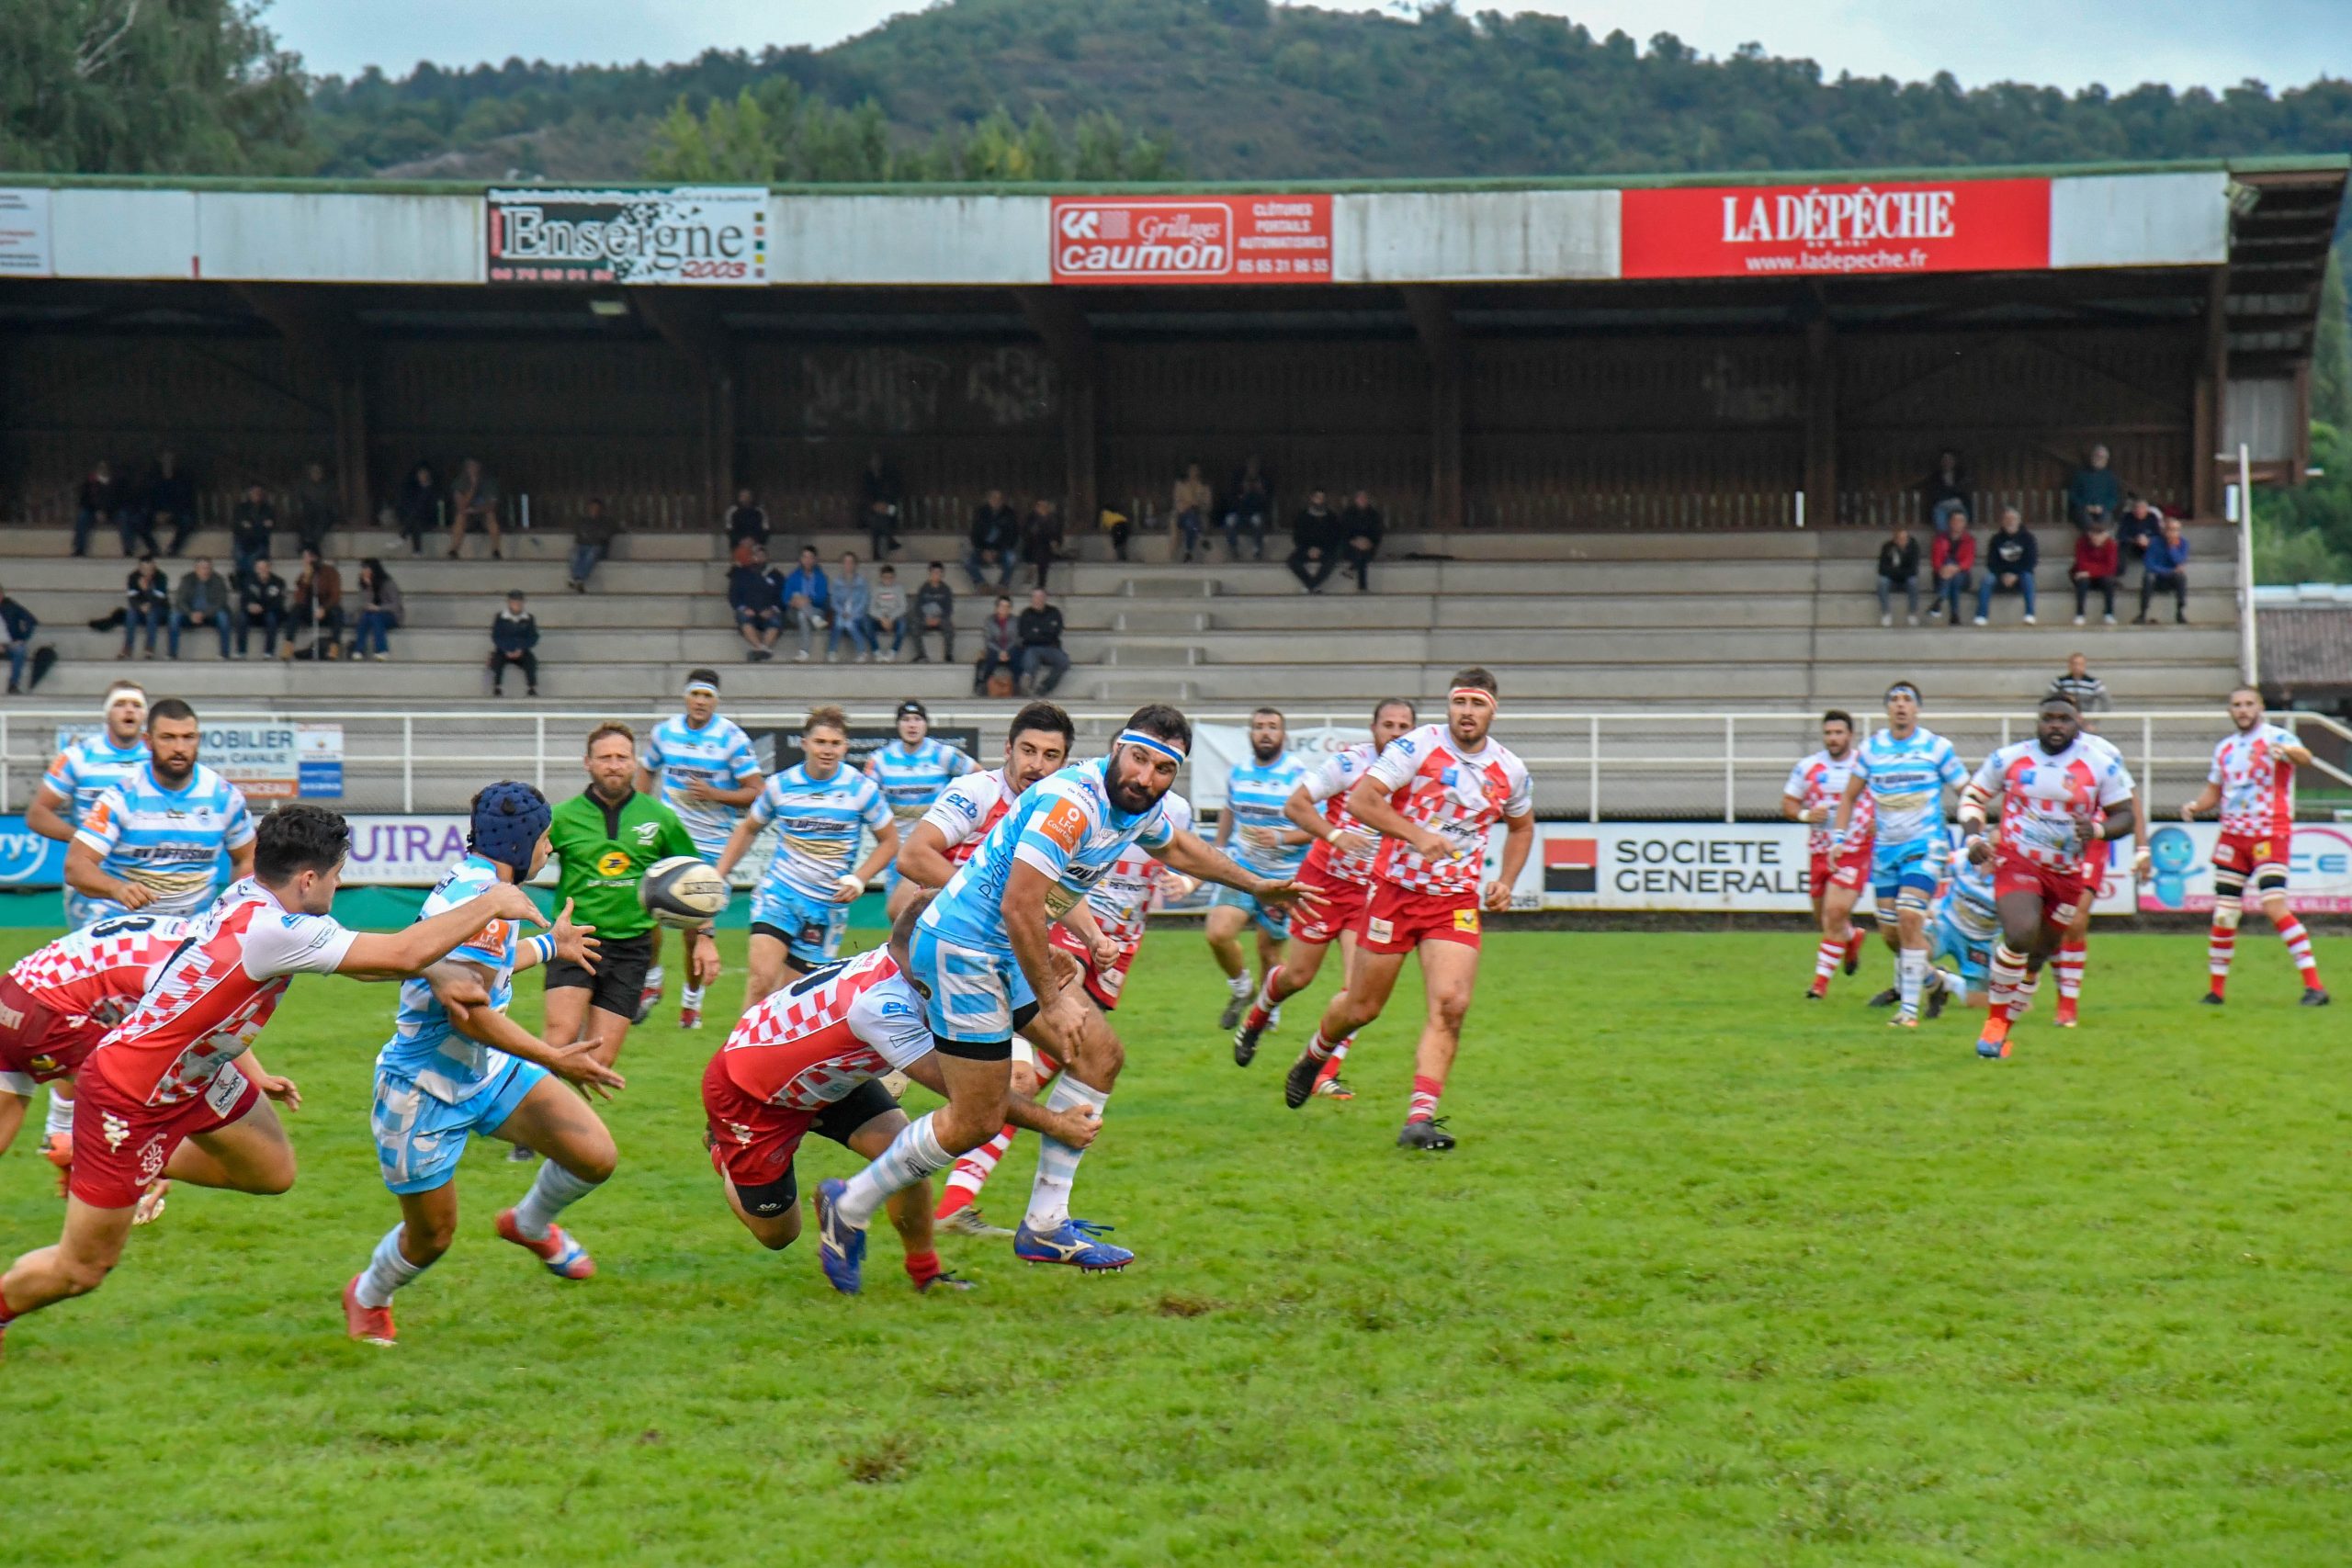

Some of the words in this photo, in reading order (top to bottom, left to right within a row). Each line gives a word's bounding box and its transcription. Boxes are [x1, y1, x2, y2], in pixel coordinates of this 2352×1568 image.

[505, 208, 744, 270] Enseigne
[681, 260, 747, 279] 2003
[1061, 244, 1224, 271] caumon
[1745, 248, 1928, 273] www.ladepeche.fr
[1058, 816, 1076, 834] LFC
[1614, 839, 1781, 864] SOCIETE
